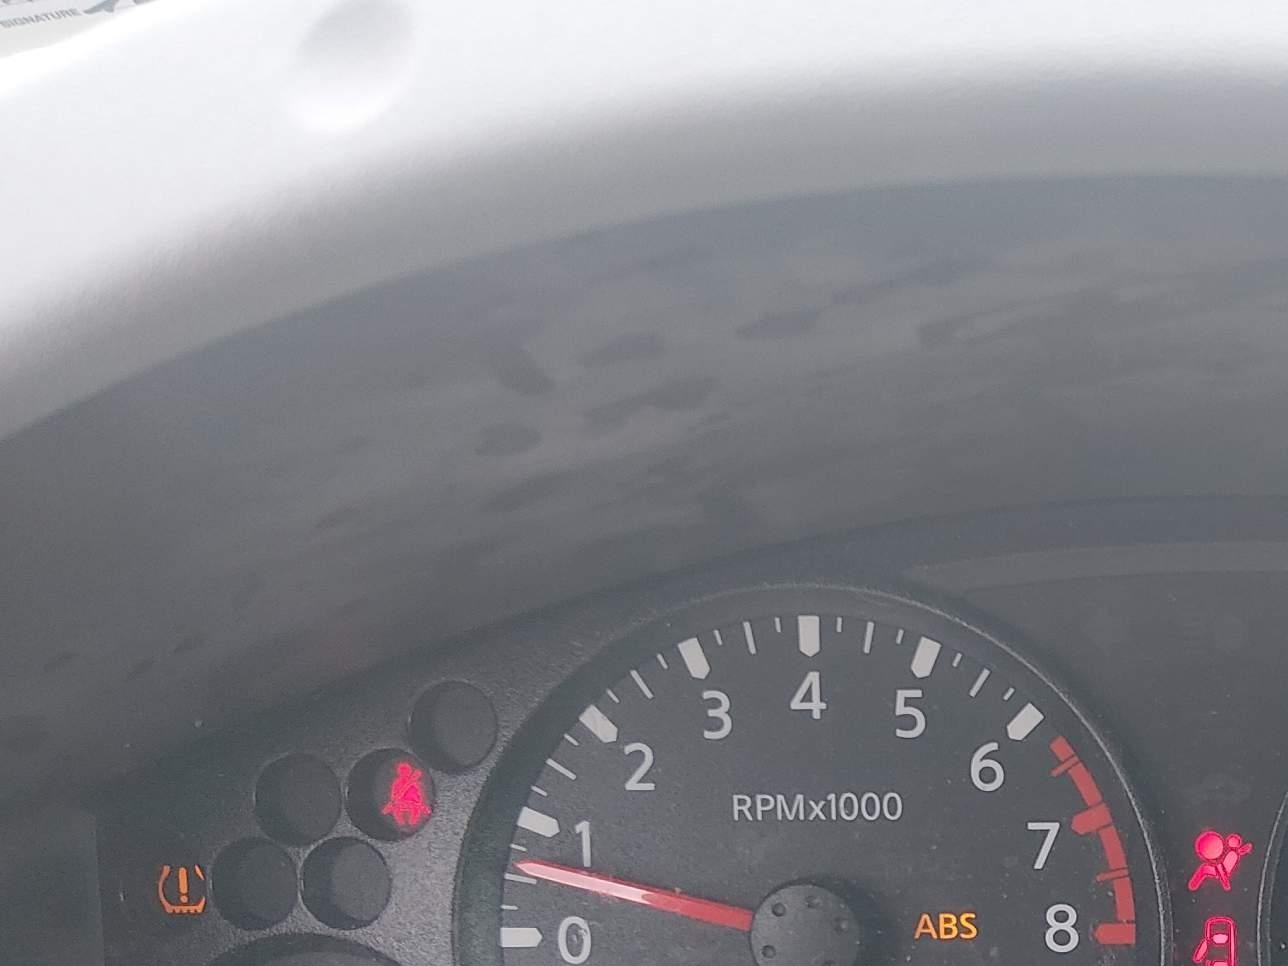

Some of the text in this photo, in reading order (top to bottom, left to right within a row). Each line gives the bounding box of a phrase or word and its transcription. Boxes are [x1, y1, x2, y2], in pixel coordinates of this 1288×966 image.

[702, 690, 732, 739] 3
[790, 671, 827, 719] 4
[895, 689, 926, 738] 5
[624, 743, 655, 790] 2
[970, 742, 1005, 791] 6
[732, 792, 903, 821] RPMx1000
[575, 820, 591, 867] 1
[1027, 822, 1060, 870] 7
[557, 915, 592, 965] 0
[915, 912, 977, 939] ABS
[1045, 903, 1079, 953] 8
